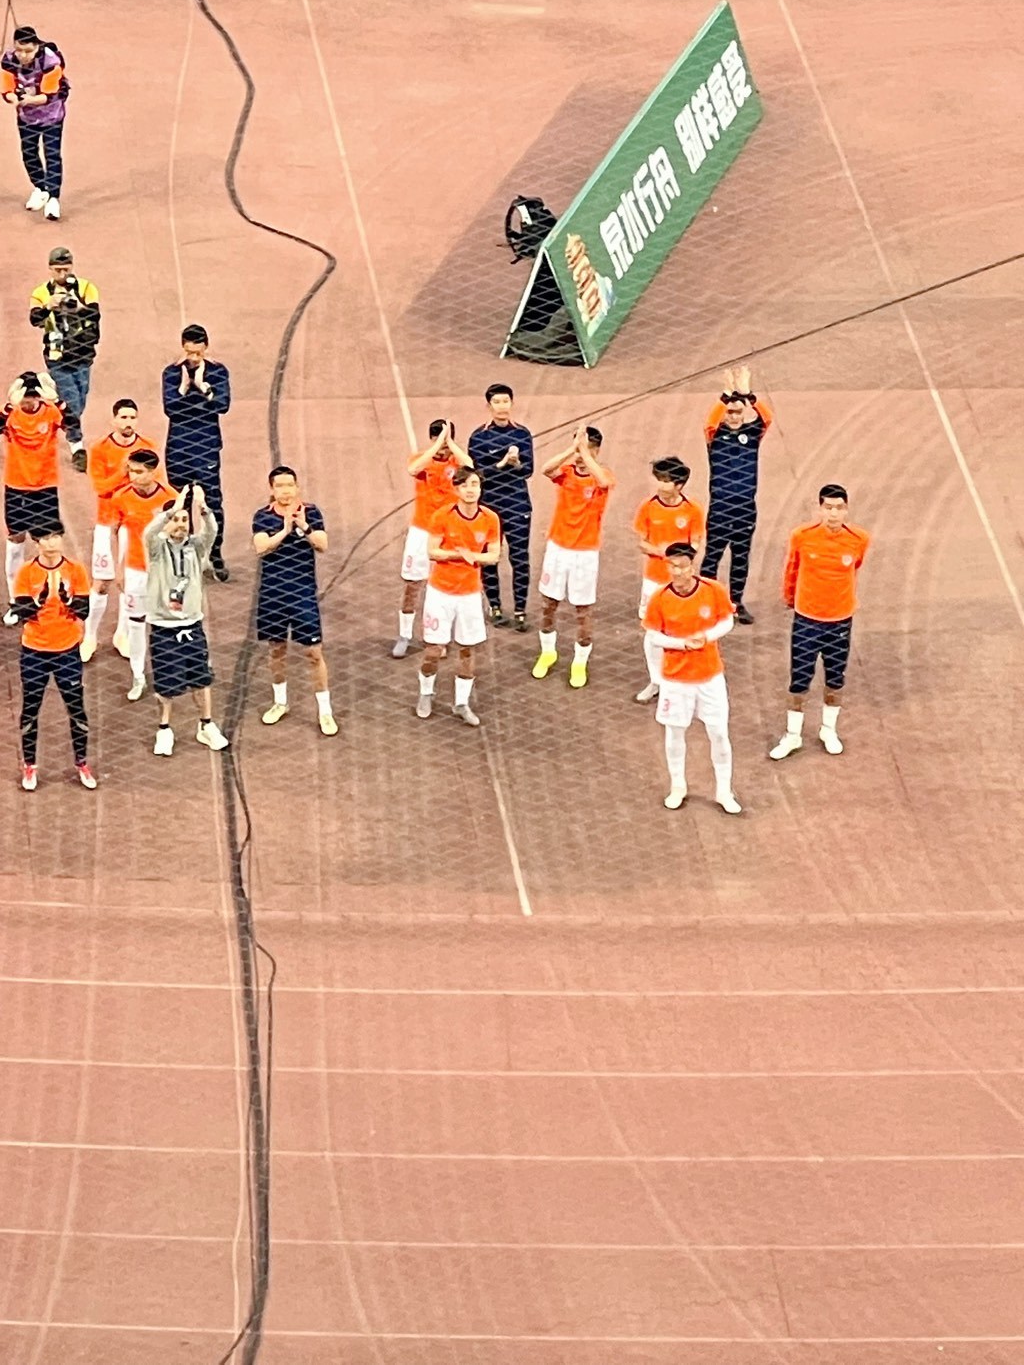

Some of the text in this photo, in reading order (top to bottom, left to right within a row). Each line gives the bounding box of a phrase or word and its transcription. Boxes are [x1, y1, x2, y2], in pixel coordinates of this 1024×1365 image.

[598, 38, 752, 280] 泉水行舟 别样感受
